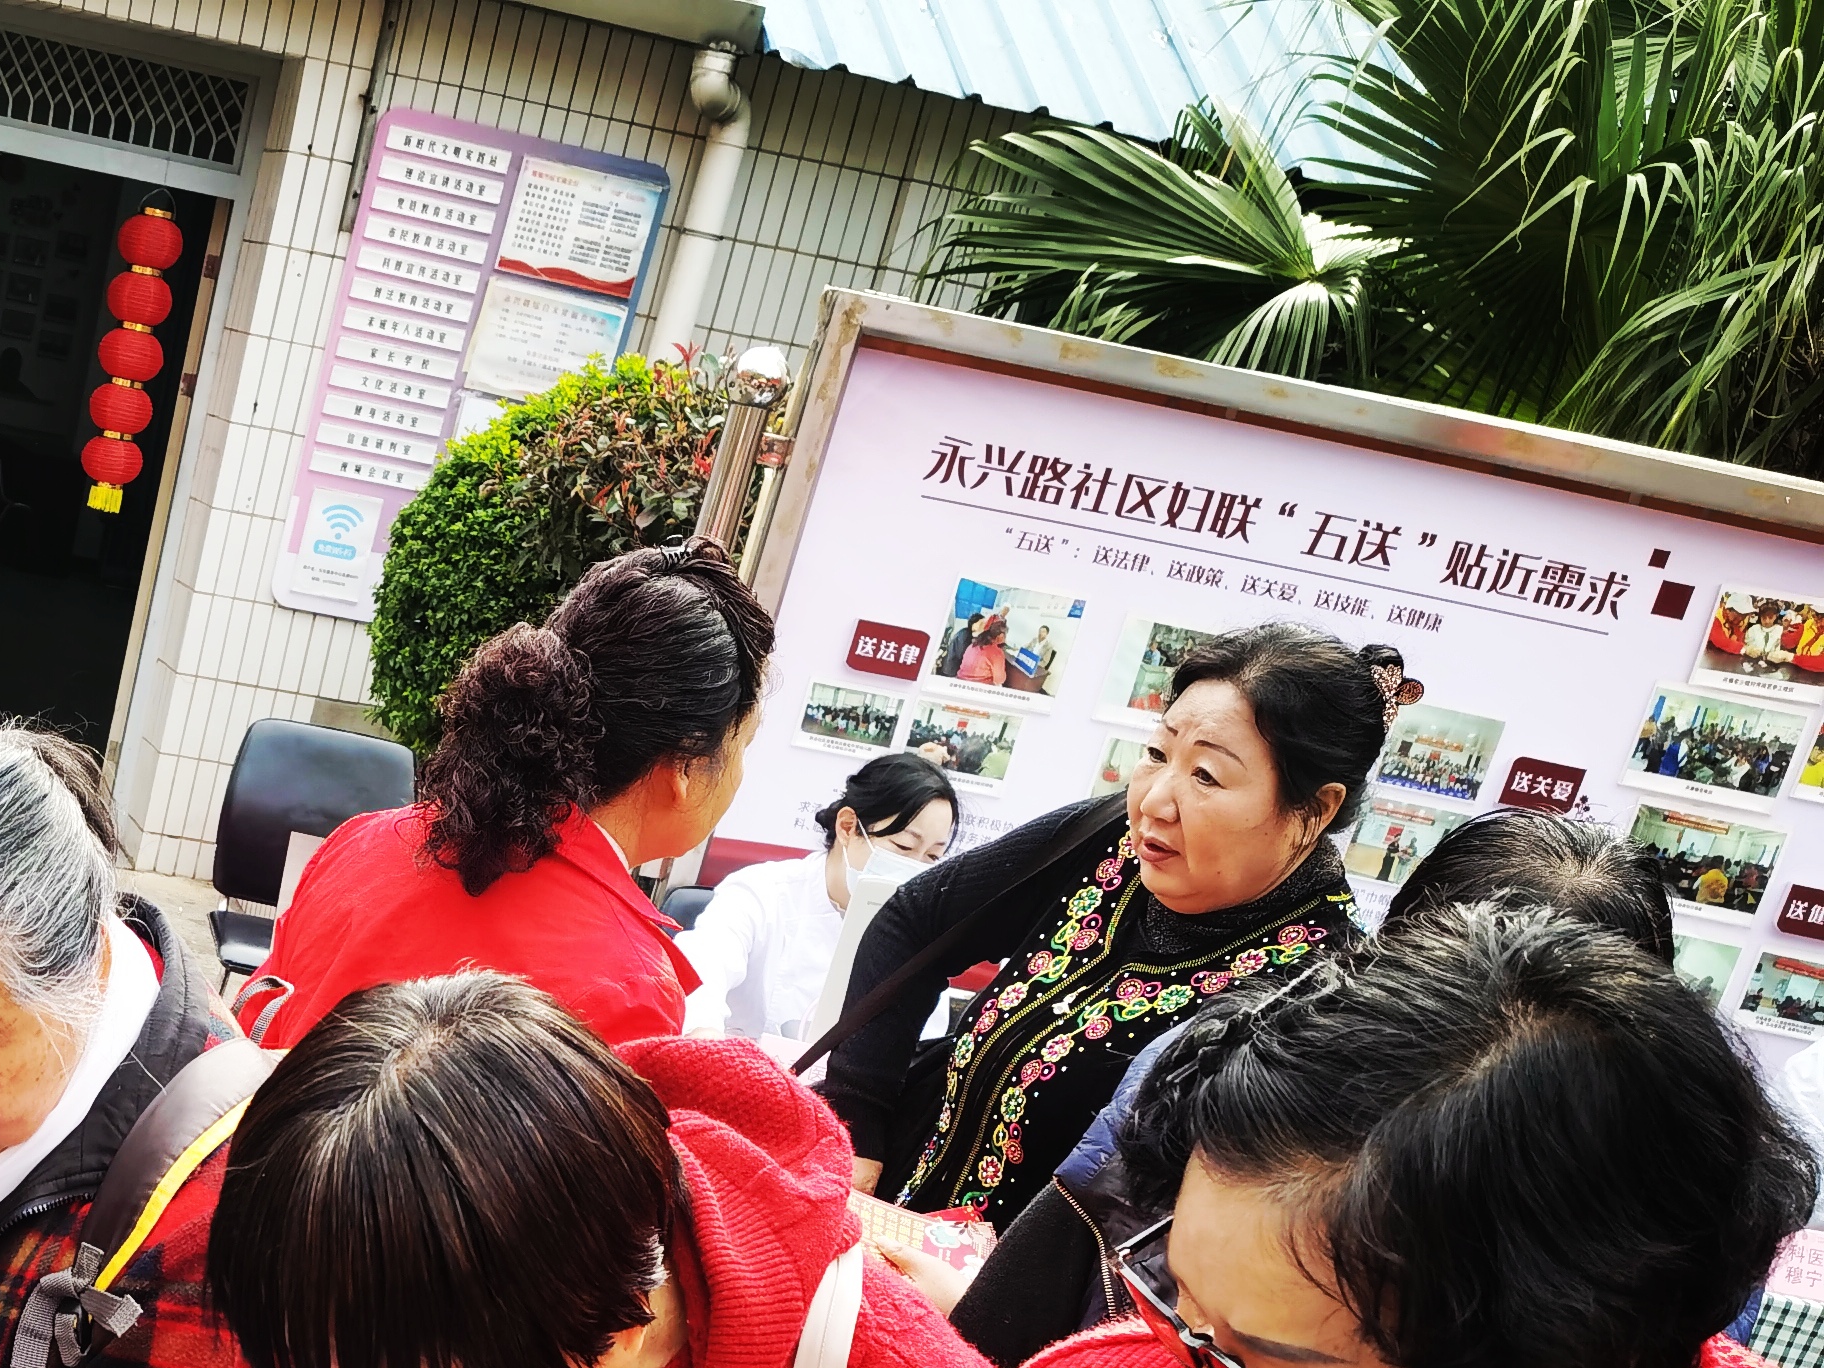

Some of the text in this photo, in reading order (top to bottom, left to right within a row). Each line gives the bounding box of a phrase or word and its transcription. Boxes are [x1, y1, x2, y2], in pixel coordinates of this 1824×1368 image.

[403, 135, 498, 167] 新时代文明实践站
[404, 167, 487, 197] 理论宣讲活动室
[367, 316, 447, 344] 未成年人活动室
[370, 347, 430, 370] 家长学校
[361, 376, 427, 400] 文化活动室
[354, 405, 419, 428] 健身活动室
[922, 436, 1631, 620] 永兴路社区妇联“五送”贴近需求
[855, 635, 921, 665] 送法律
[1510, 771, 1575, 801] 送关爱
